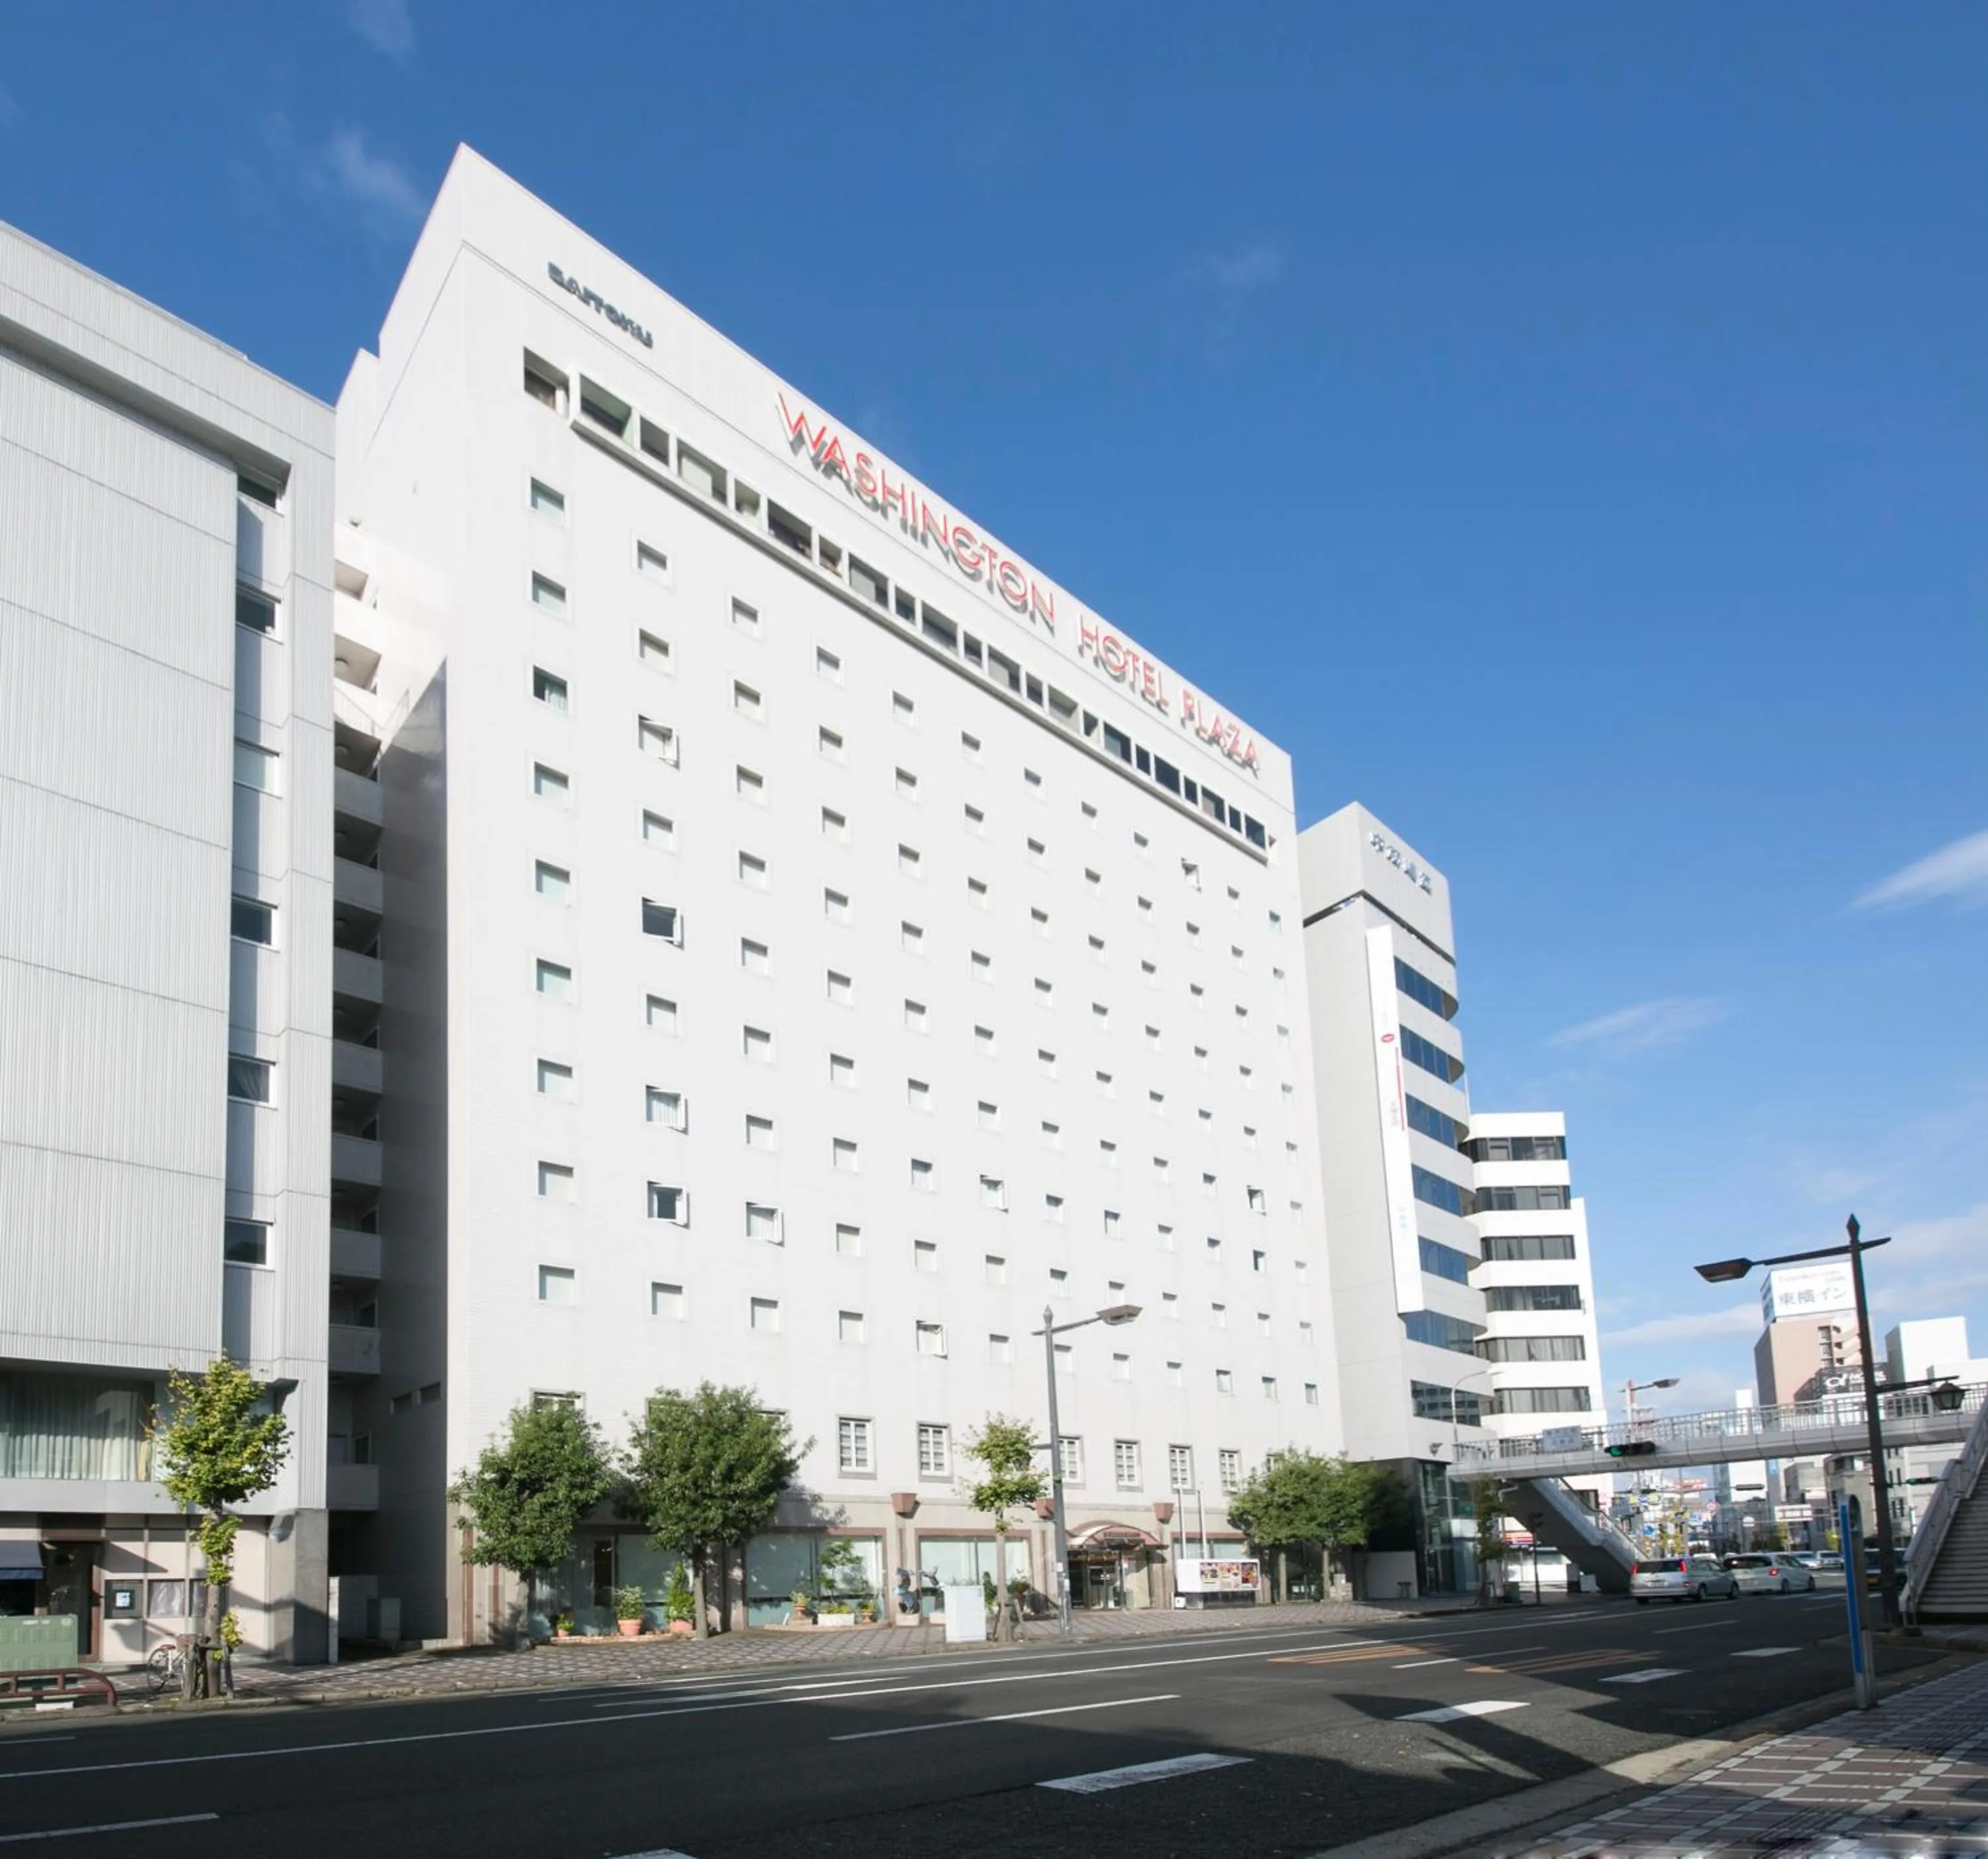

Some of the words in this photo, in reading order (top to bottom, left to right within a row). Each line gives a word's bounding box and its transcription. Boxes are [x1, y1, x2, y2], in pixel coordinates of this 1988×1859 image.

[777, 392, 1055, 625] WASHINGTON
[1079, 614, 1170, 708] HOTEL
[1182, 688, 1258, 769] PLAZA
